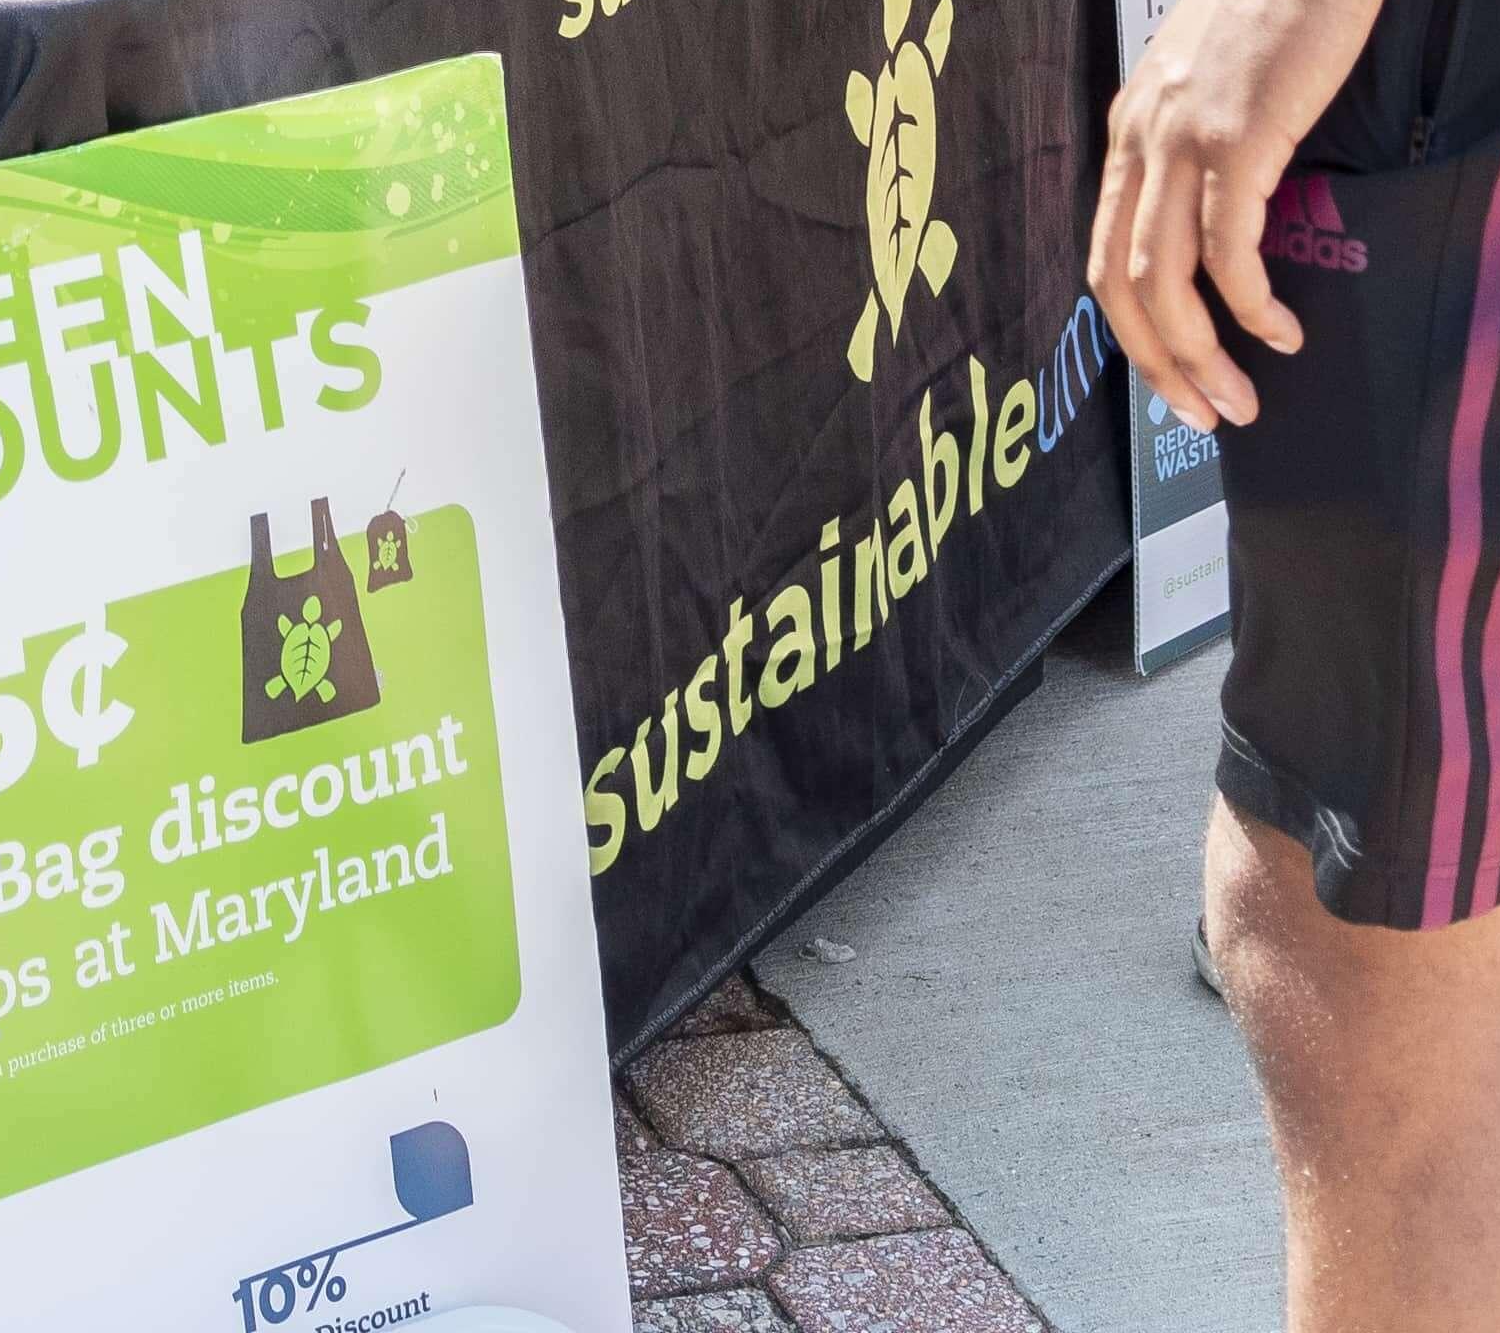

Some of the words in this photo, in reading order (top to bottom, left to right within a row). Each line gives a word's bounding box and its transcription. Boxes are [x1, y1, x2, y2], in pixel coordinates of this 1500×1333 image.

[584, 295, 1121, 876] sustainableum
[149, 711, 469, 865] discount
[75, 921, 136, 990] at
[153, 813, 454, 968] Maryland
[8, 1034, 87, 1078] purchase
[90, 1023, 107, 1046] of
[111, 1008, 156, 1038] three
[159, 1002, 177, 1021] or
[180, 987, 226, 1015] more
[228, 968, 280, 998] items.
[232, 1248, 347, 1333] 10%
